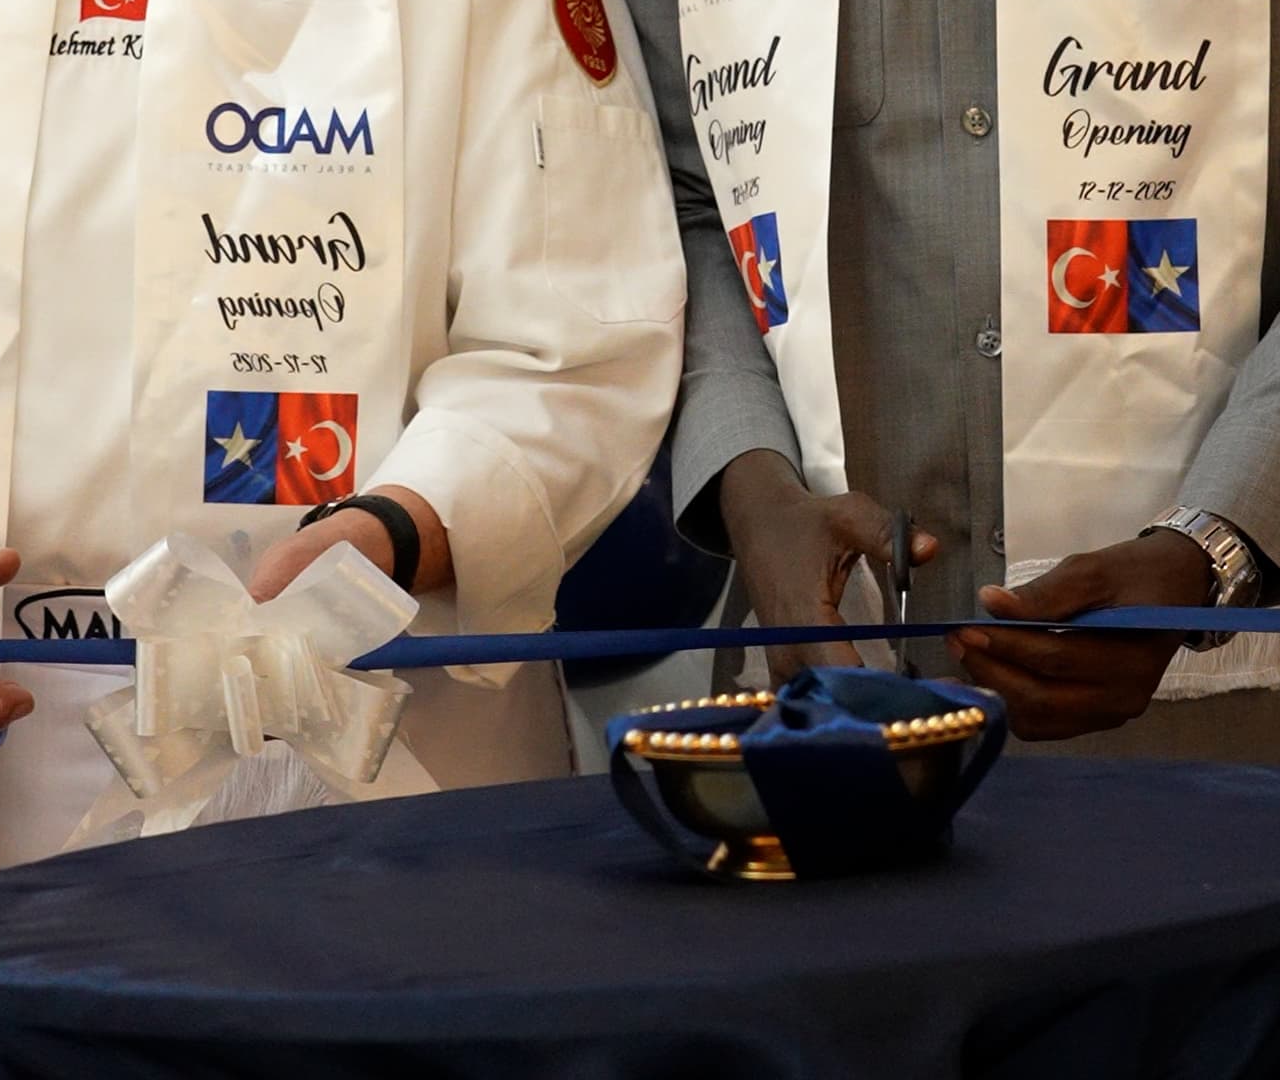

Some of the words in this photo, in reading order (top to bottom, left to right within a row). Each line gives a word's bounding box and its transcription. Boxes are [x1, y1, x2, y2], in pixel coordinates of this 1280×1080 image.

[686, 35, 781, 116] Grand
[1043, 36, 1211, 97] Grand
[1063, 108, 1192, 159] Opening
[1078, 180, 1176, 201] 12-12-2025
